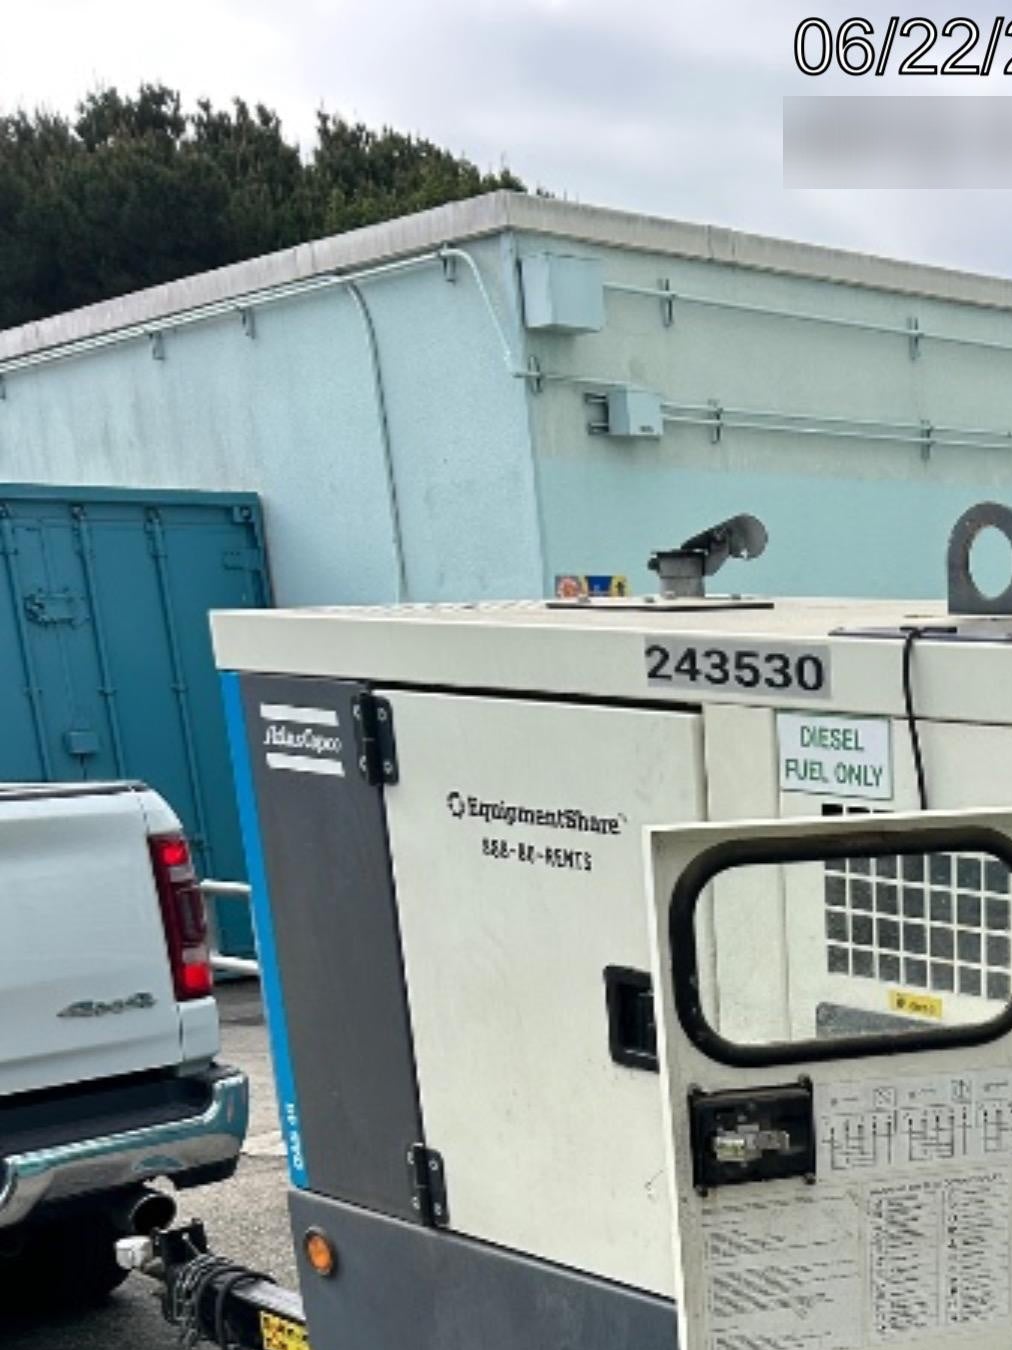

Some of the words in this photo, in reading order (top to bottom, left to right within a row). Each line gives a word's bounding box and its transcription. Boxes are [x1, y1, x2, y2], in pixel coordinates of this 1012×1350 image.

[645, 643, 824, 691] 243530
[799, 725, 865, 751] DIESEL
[785, 758, 829, 783] FUEL
[833, 761, 883, 788] ONLY
